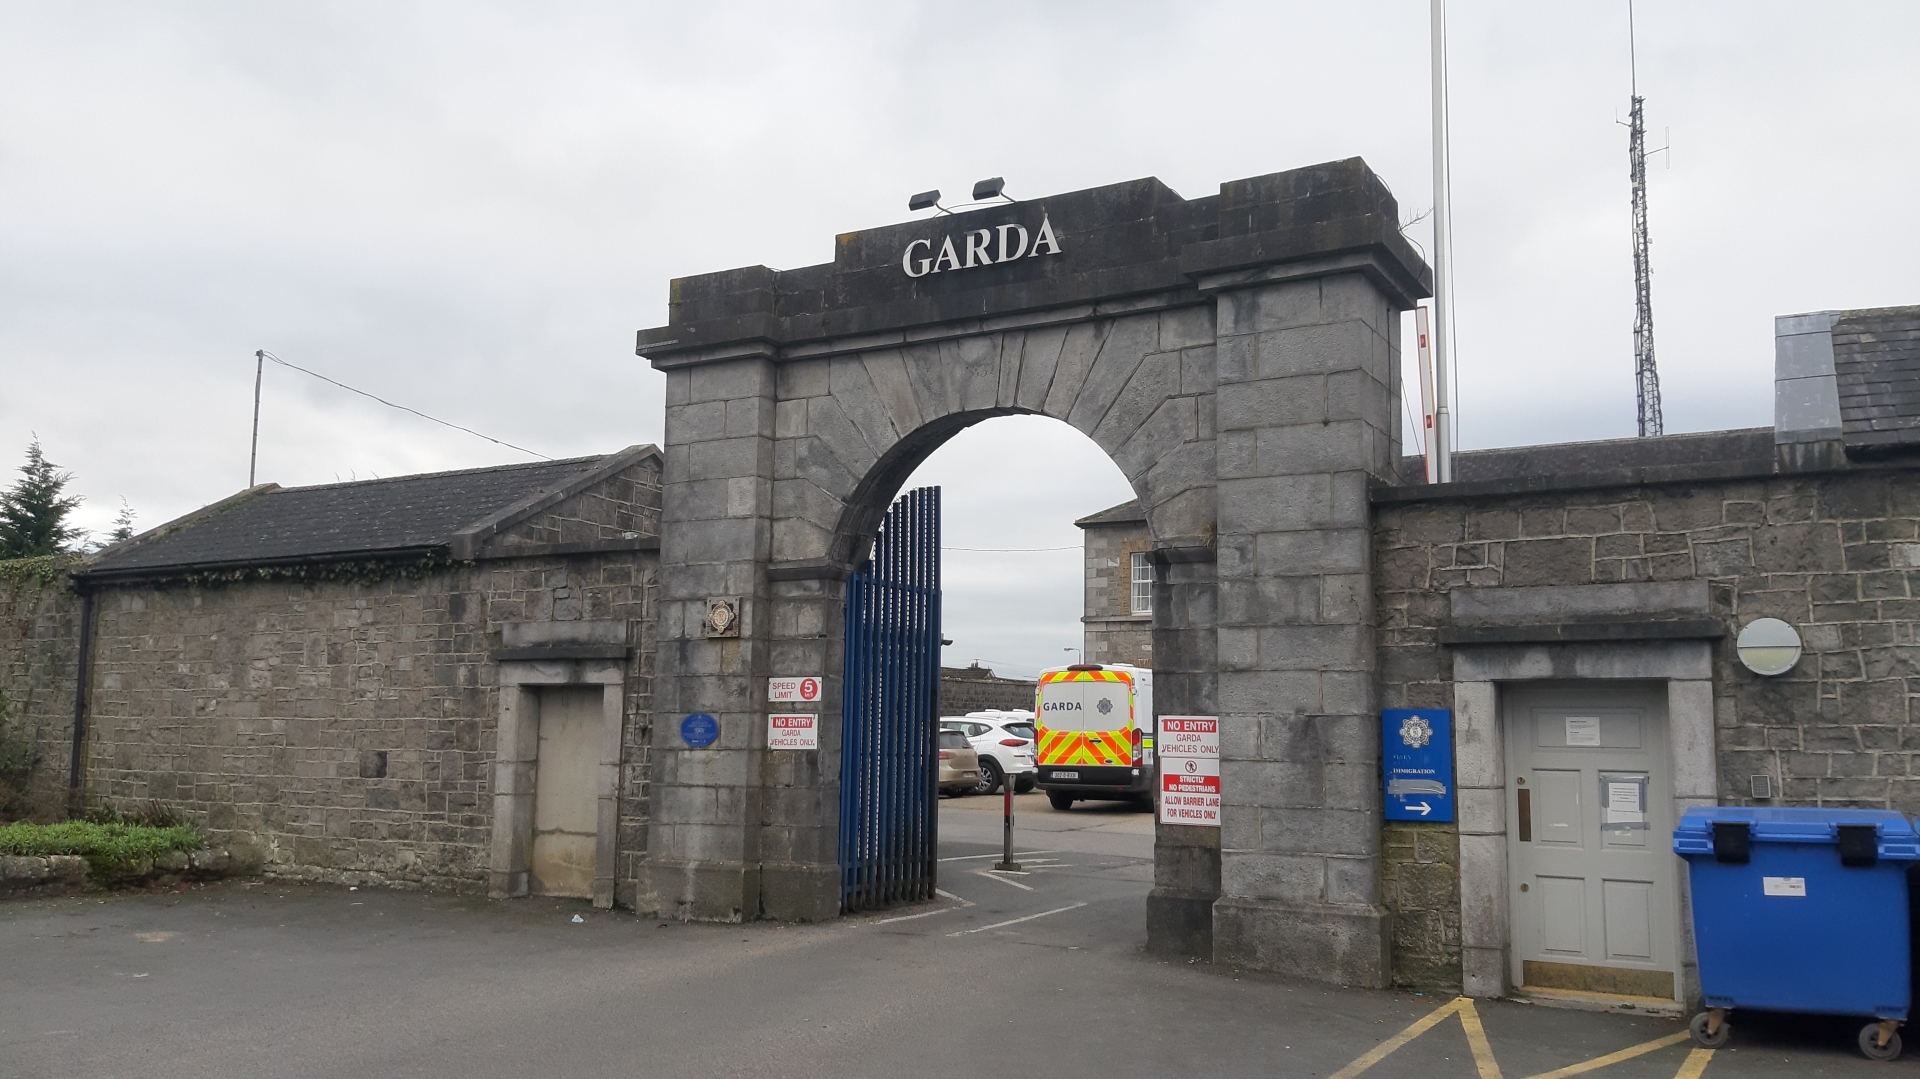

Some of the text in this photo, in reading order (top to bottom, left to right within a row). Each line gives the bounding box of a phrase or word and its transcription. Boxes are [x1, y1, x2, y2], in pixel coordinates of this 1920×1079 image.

[902, 214, 1062, 278] GARDA
[804, 681, 813, 692] 5
[1043, 702, 1082, 711] GARDA
[776, 718, 811, 726] NO ENTRY
[1167, 720, 1214, 732] NO ENTRY
[782, 729, 801, 737] GARDA
[1176, 733, 1201, 742] GARDA
[1162, 744, 1219, 754] VEHICLES ONLY
[1179, 775, 1204, 783] STRICTLY
[1178, 785, 1215, 793] PEDESTRIANS
[1165, 796, 1219, 807] ALLOW BARRIER LANE
[1167, 808, 1216, 820] FOR VEHICLES ONLY
